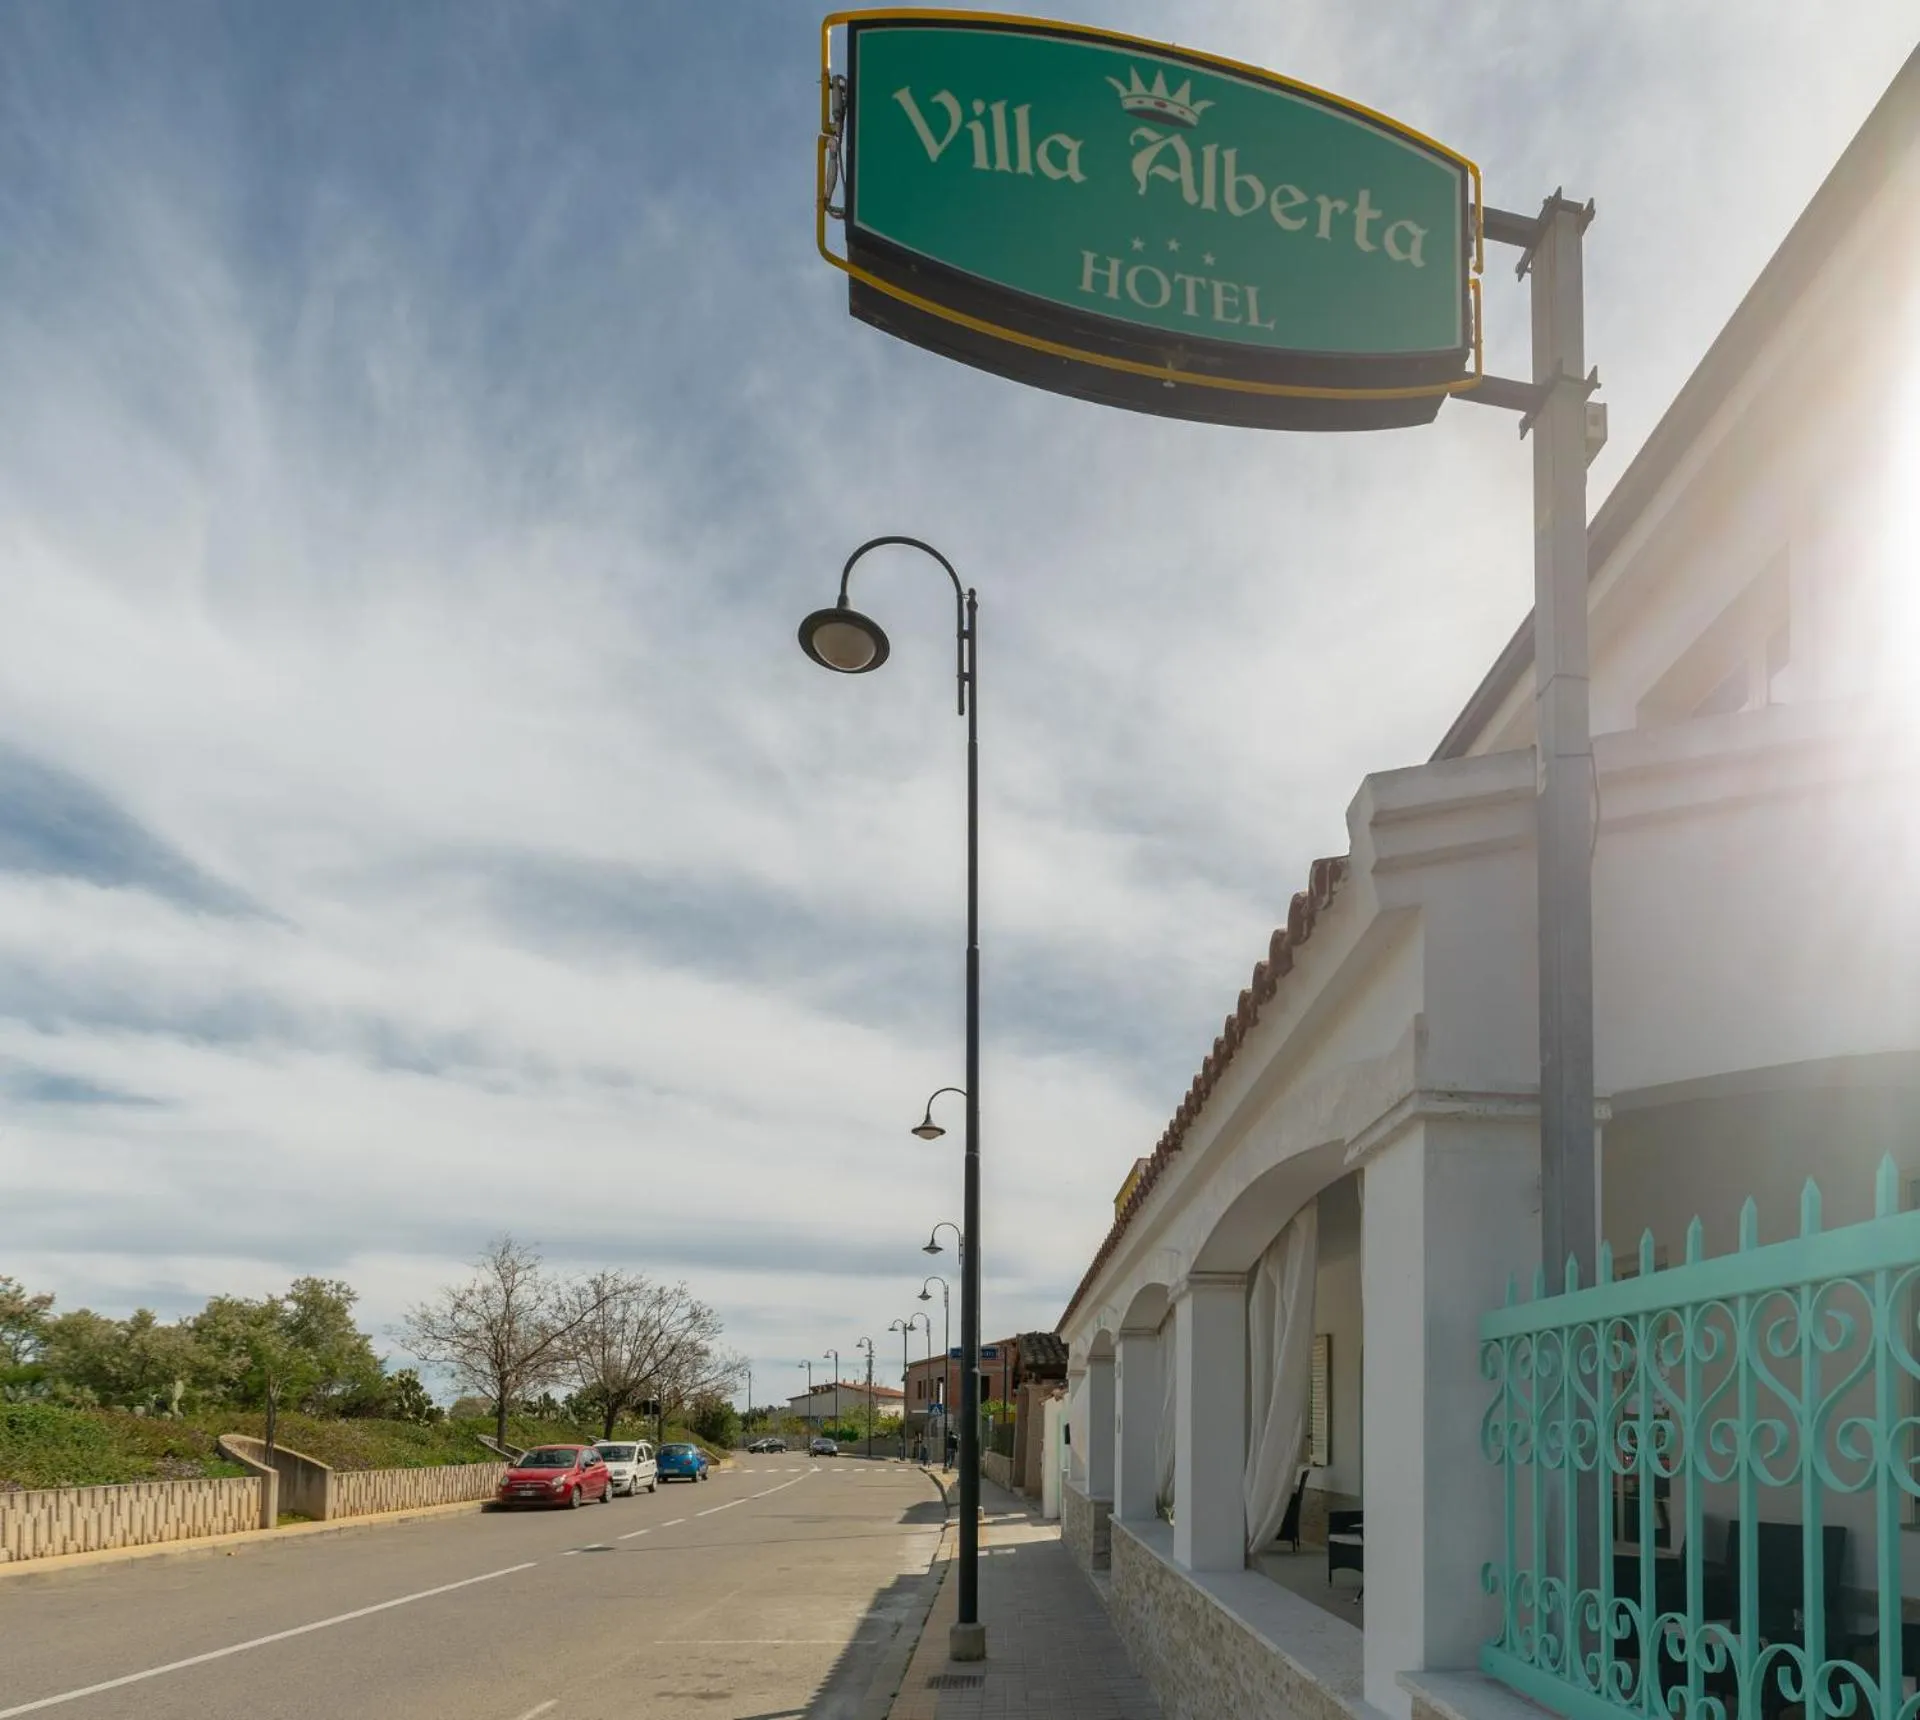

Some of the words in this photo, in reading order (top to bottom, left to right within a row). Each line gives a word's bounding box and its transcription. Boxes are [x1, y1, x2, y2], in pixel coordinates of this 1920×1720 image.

[893, 86, 1087, 184] Villa
[1129, 126, 1428, 268] Alberta
[1079, 250, 1276, 331] HOTEL
